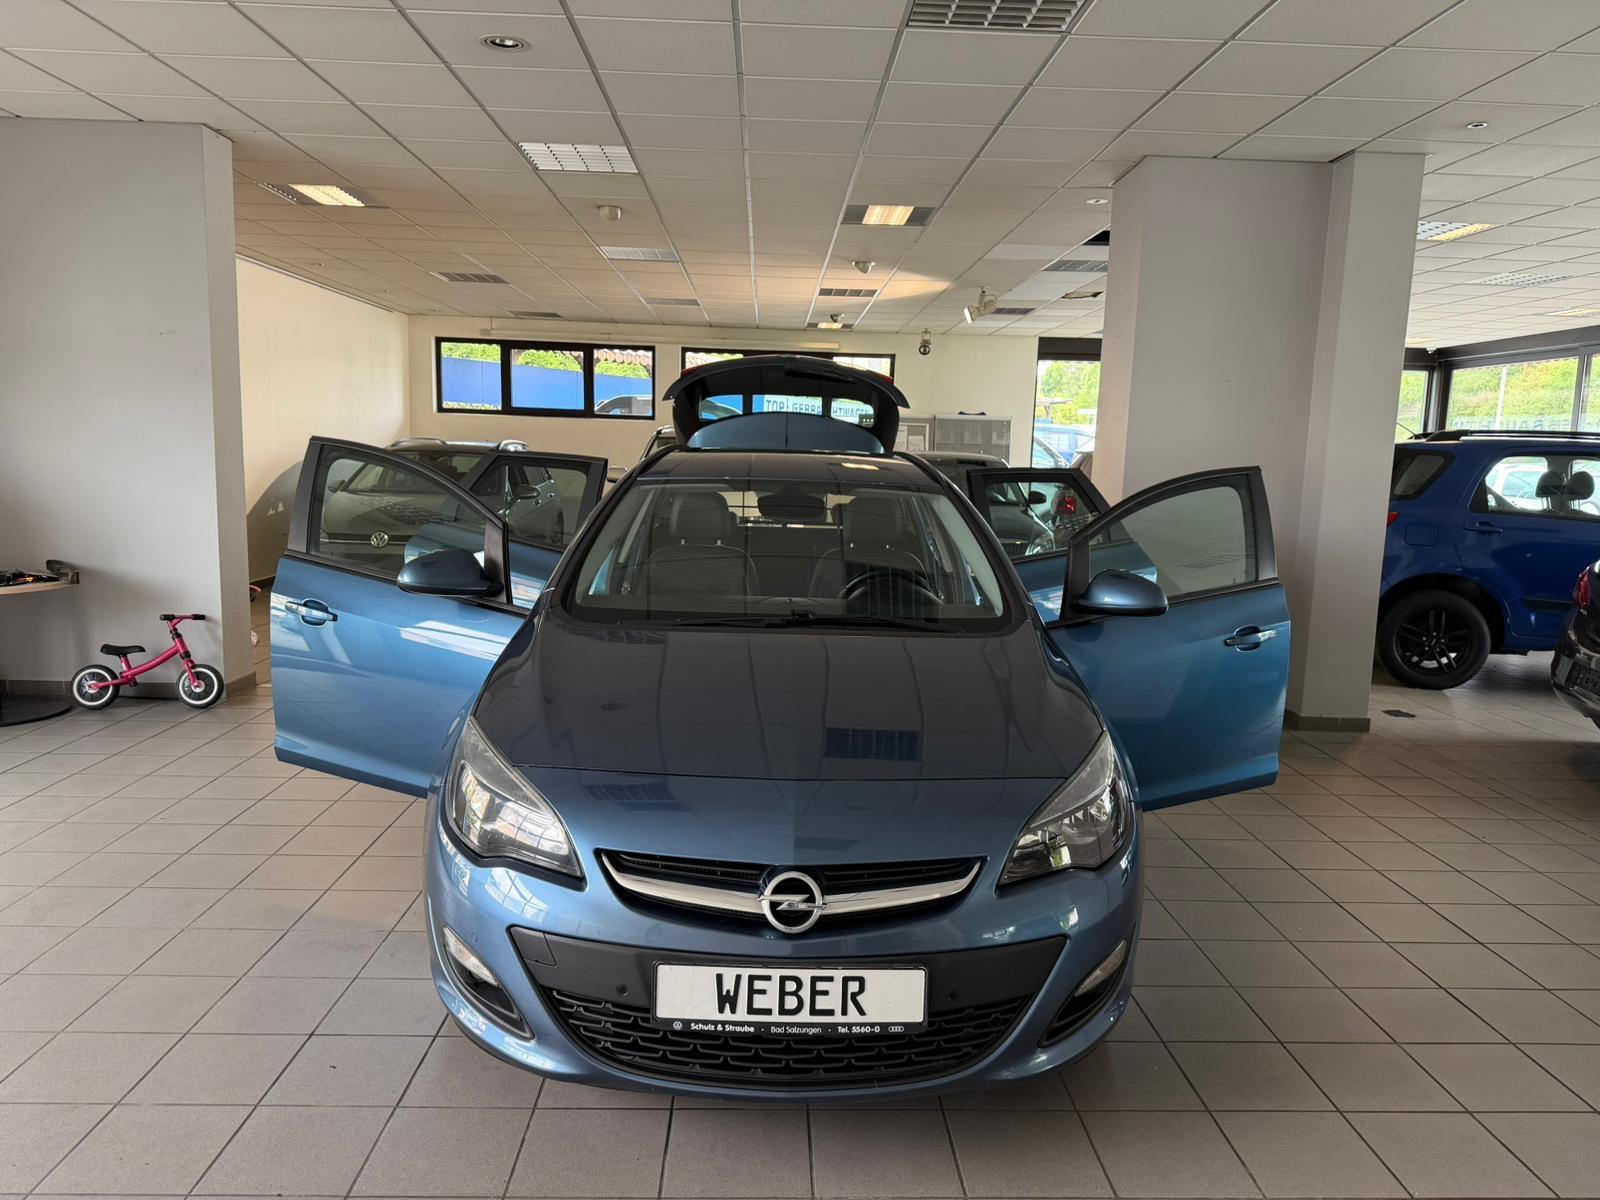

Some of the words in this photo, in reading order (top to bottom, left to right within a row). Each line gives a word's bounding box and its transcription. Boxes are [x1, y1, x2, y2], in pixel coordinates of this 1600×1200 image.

[715, 973, 867, 1016] WEBER
[690, 1023, 715, 1031] Schulz
[724, 1024, 755, 1033] Straube
[786, 1026, 822, 1035] Salzungen
